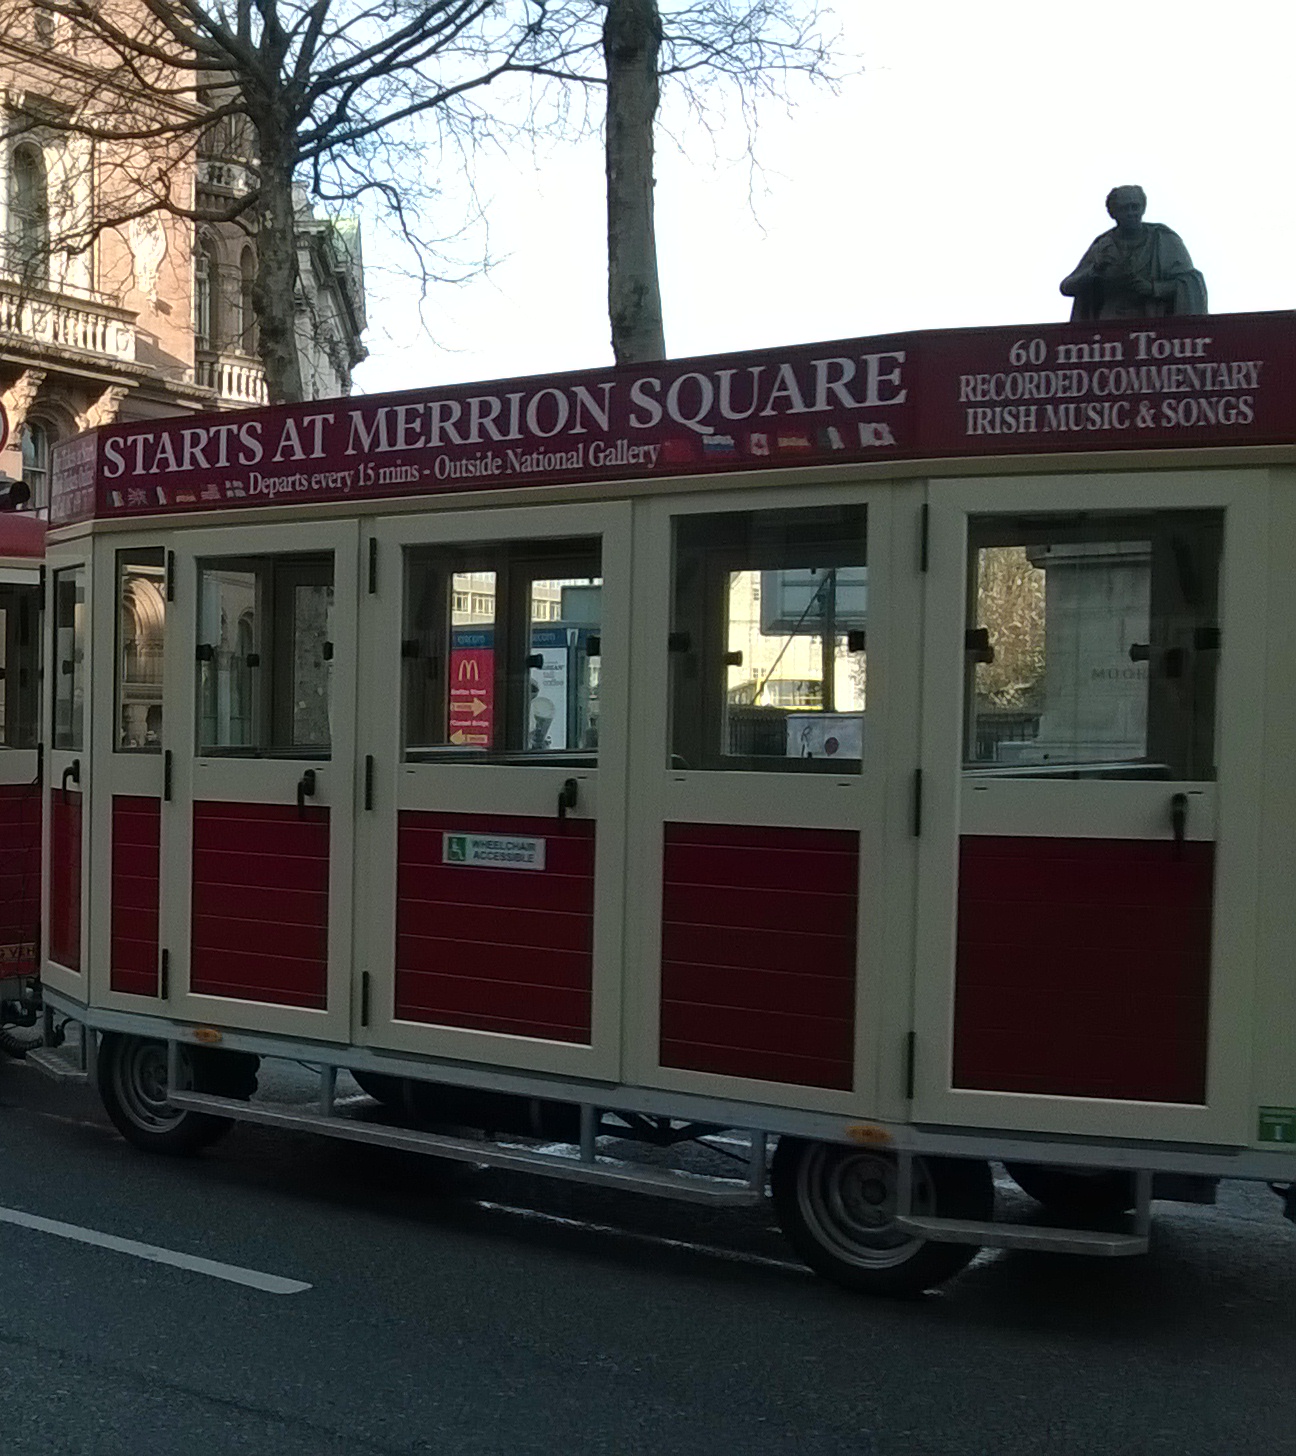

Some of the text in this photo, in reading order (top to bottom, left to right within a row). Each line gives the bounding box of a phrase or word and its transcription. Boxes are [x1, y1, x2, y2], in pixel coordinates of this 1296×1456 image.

[1008, 331, 1213, 366] 60 min Tour
[958, 360, 1264, 402] RECORDED COMMENTARY
[103, 421, 264, 478] STARTS
[271, 413, 335, 463] AT
[344, 382, 616, 455] MERRION
[629, 350, 908, 435] SQUARE
[965, 395, 1255, 435] IRISH MUSIC & SONGS
[249, 471, 308, 498] Departs
[311, 469, 354, 492] every
[357, 462, 375, 486] 15
[378, 459, 419, 485] mins
[434, 451, 502, 480] Outside
[505, 443, 584, 475] National
[589, 438, 661, 469] Gallery
[471, 840, 536, 852] WHEELCHAIR
[472, 850, 535, 863] ACCESSIBLE
